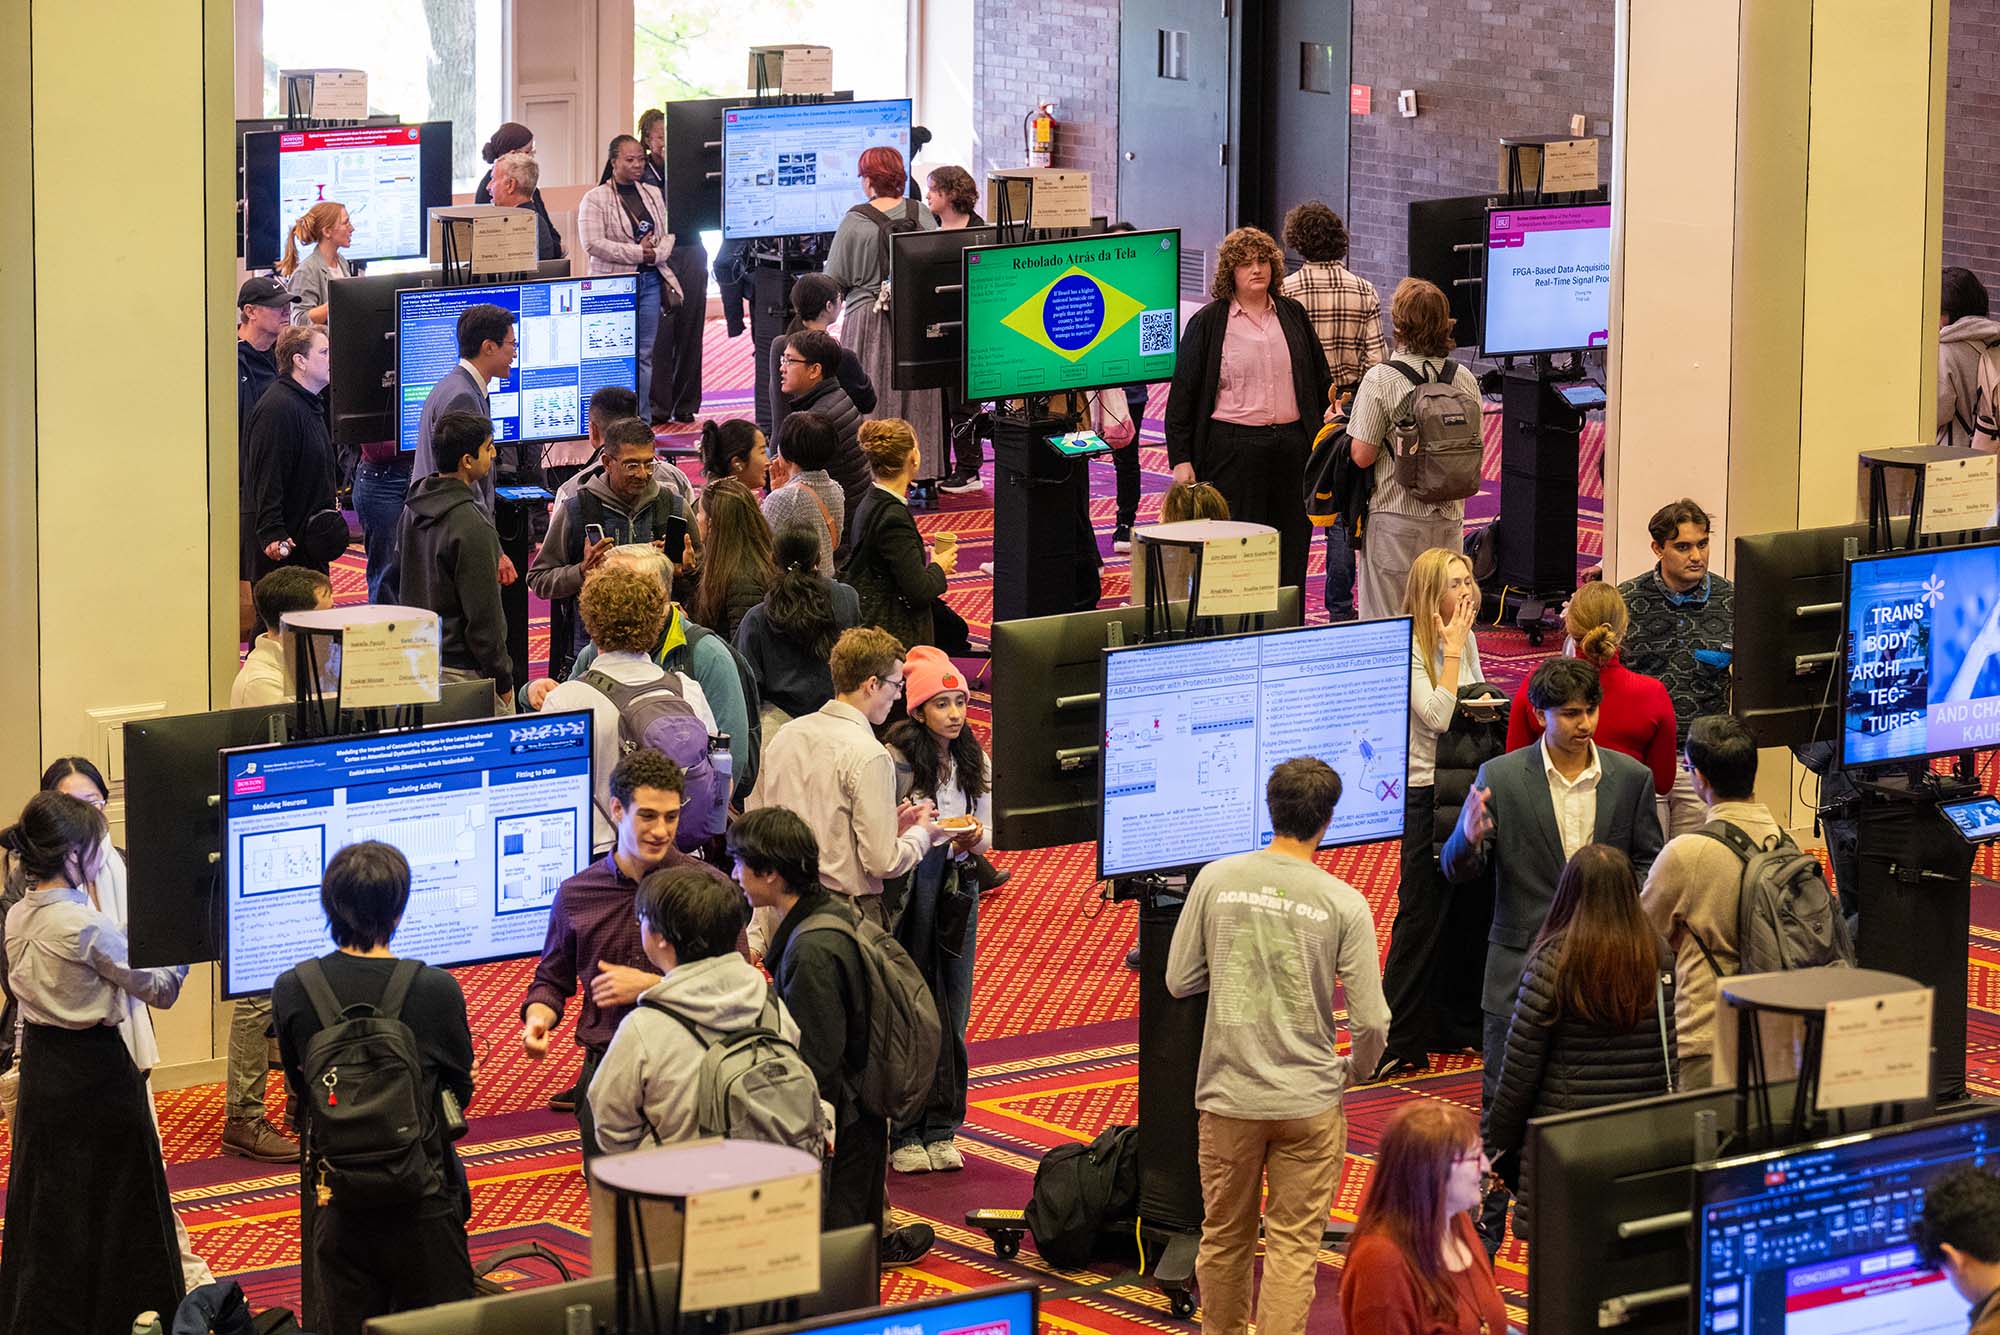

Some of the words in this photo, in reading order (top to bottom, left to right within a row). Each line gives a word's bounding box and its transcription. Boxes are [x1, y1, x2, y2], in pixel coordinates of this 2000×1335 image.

[1013, 255, 1063, 270] Rebolado
[1066, 251, 1095, 264] Atrás
[1098, 250, 1111, 261] da
[1114, 247, 1136, 260] Tela
[1512, 266, 1555, 276] FPGA-Based
[1558, 265, 1574, 274] Data
[1535, 278, 1571, 287] Real-Time
[1573, 275, 1593, 286] Signal
[1872, 602, 1924, 625] TRANS
[1866, 631, 1910, 653] BODY
[1336, 660, 1349, 668] and
[1350, 658, 1372, 667] Future
[1372, 655, 1406, 665] Directions
[1137, 683, 1166, 693] turnover
[1167, 681, 1181, 689] with
[1224, 673, 1254, 683] Inhibitors
[1868, 711, 1920, 733] TURES
[1936, 705, 1969, 725] AND
[336, 748, 358, 758] Modeling
[367, 744, 385, 754] Impacts
[391, 740, 420, 751] Connectivity
[420, 738, 439, 748] Changes
[454, 734, 469, 742] Lateral
[469, 731, 493, 740] Prefrontal
[367, 751, 393, 760] Attentional
[393, 747, 421, 758] Dysfunction
[426, 745, 442, 753] Autism
[442, 742, 464, 752] Spectrum
[464, 740, 484, 748] Disorder
[515, 770, 535, 780] Fitting
[542, 768, 556, 776] Data
[388, 785, 419, 794] Simulating
[420, 781, 442, 790] Activity
[252, 801, 281, 811] Modeling
[281, 799, 308, 807] Neurons
[1216, 891, 1295, 912] ACADEMY
[1295, 903, 1328, 921] CUP
